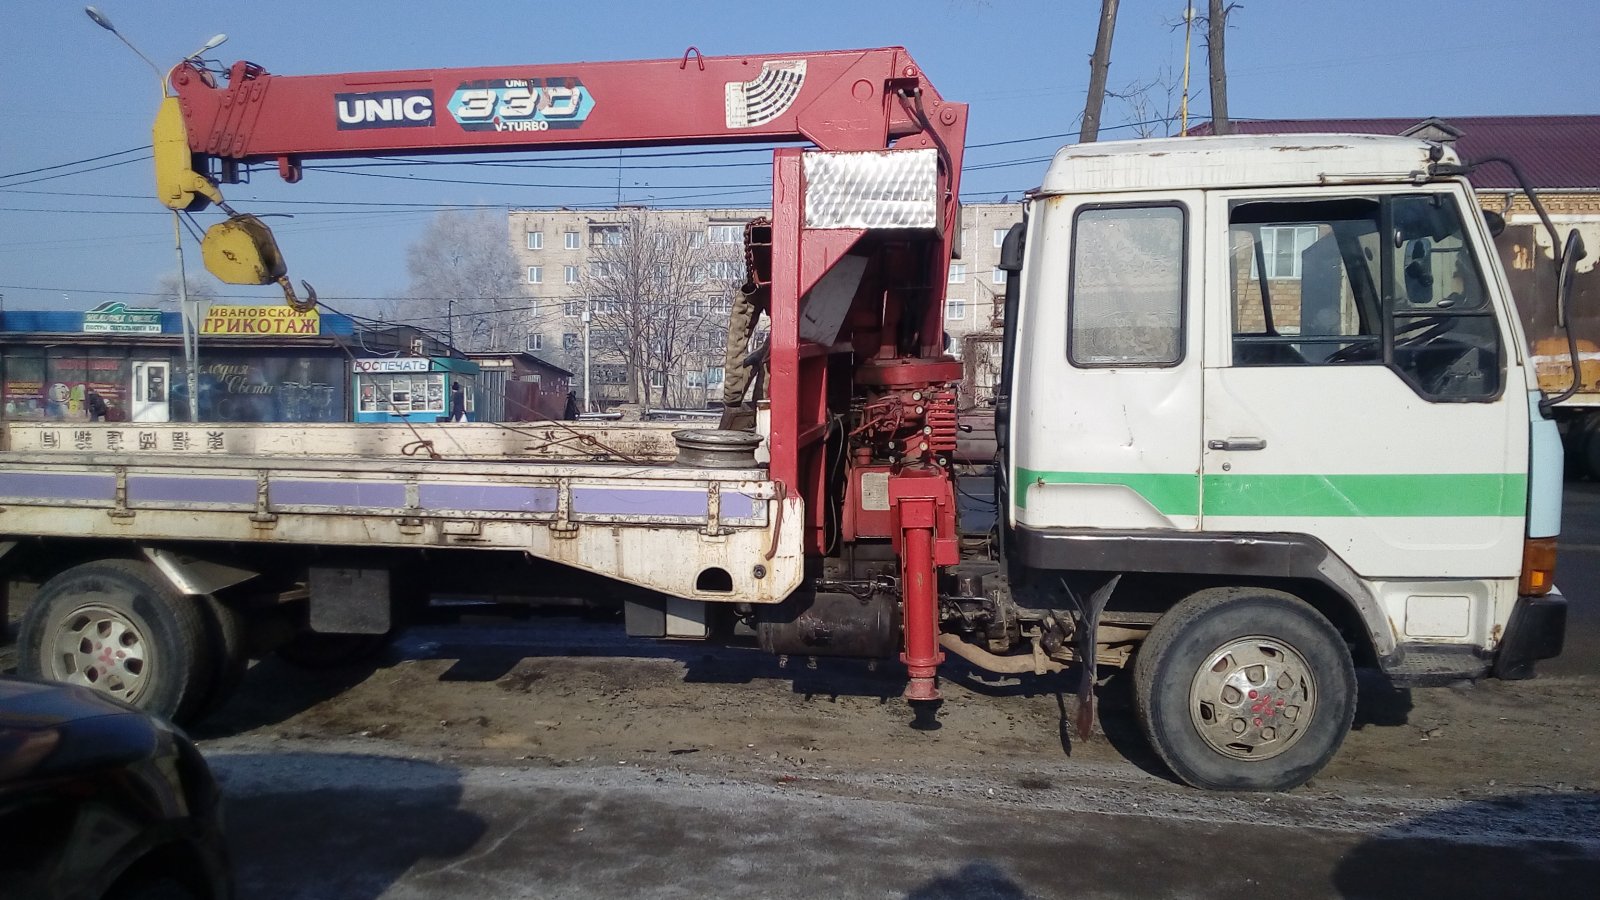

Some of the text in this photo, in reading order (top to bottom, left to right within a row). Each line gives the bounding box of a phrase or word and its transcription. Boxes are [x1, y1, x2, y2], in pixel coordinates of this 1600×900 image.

[338, 95, 433, 124] UNIC
[457, 87, 581, 119] 330
[495, 121, 549, 132] V-TURBO
[355, 361, 426, 372] РОСПЕЧАТЬ
